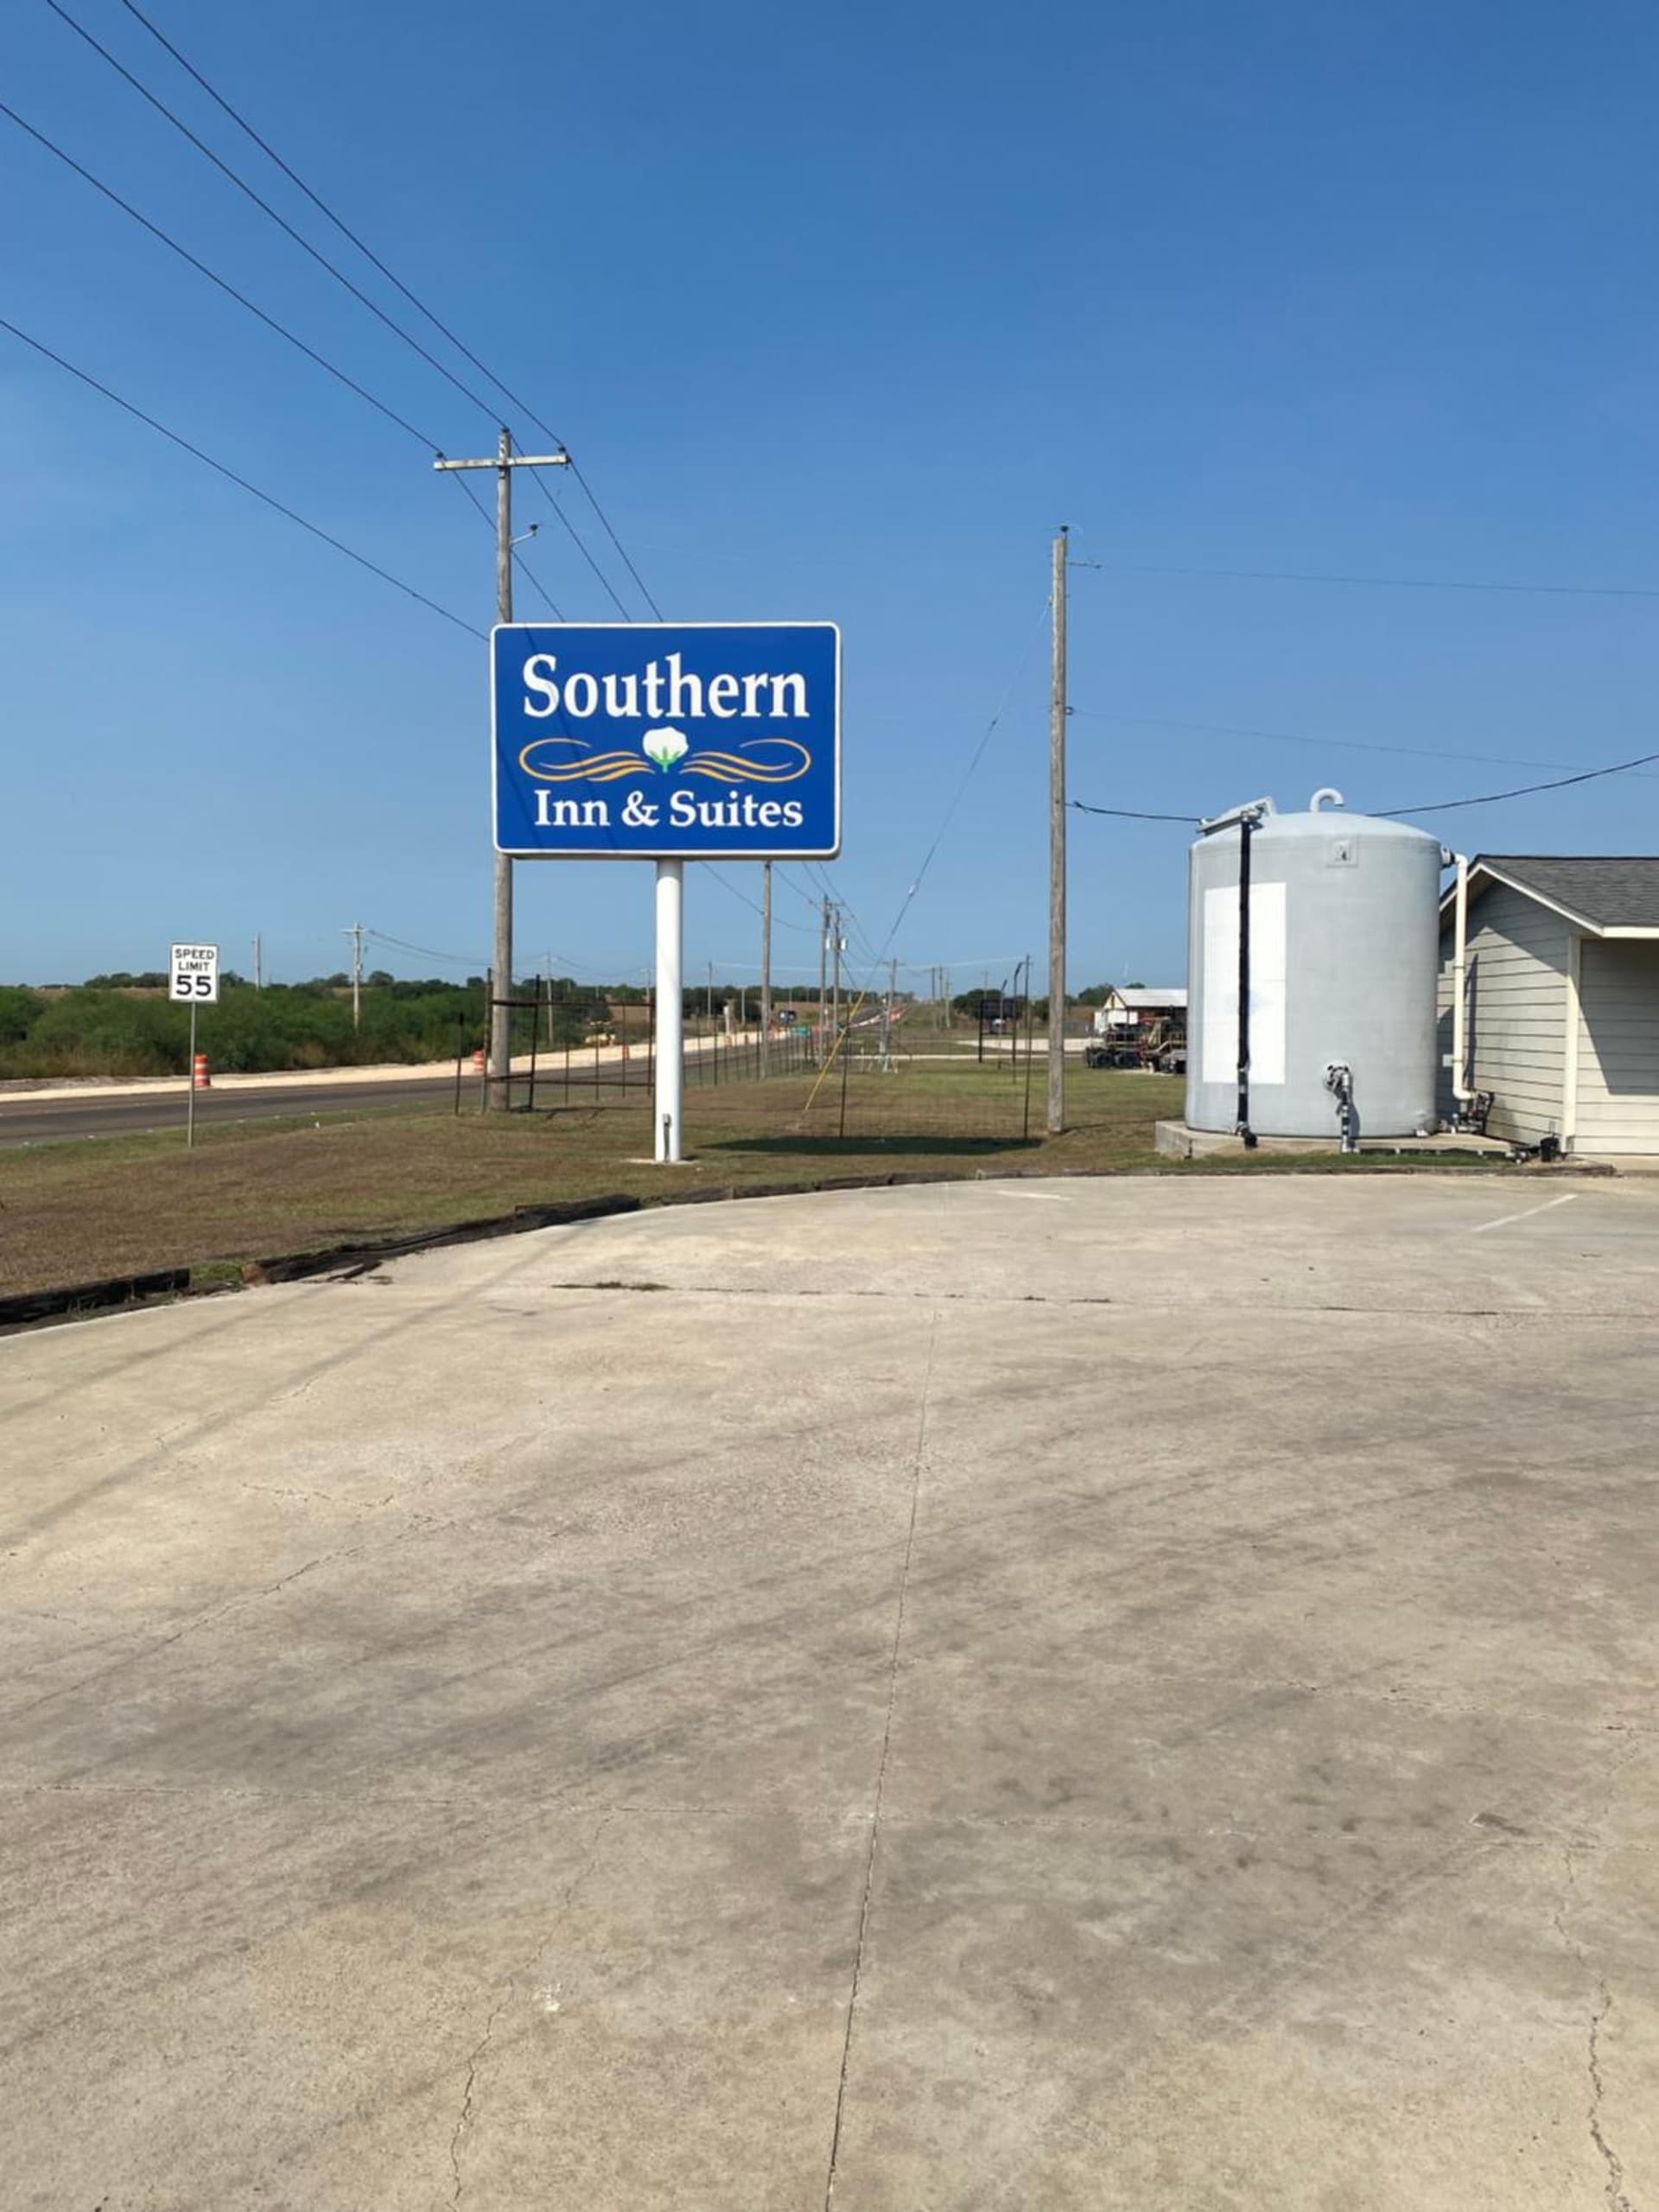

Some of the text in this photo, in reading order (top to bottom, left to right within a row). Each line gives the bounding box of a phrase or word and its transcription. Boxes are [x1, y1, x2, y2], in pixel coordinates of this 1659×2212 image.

[522, 652, 810, 720] Southern
[534, 789, 804, 827] Inn & Suites
[175, 948, 215, 960] SPEED
[178, 961, 210, 972] LIMIT
[175, 974, 213, 996] 55
